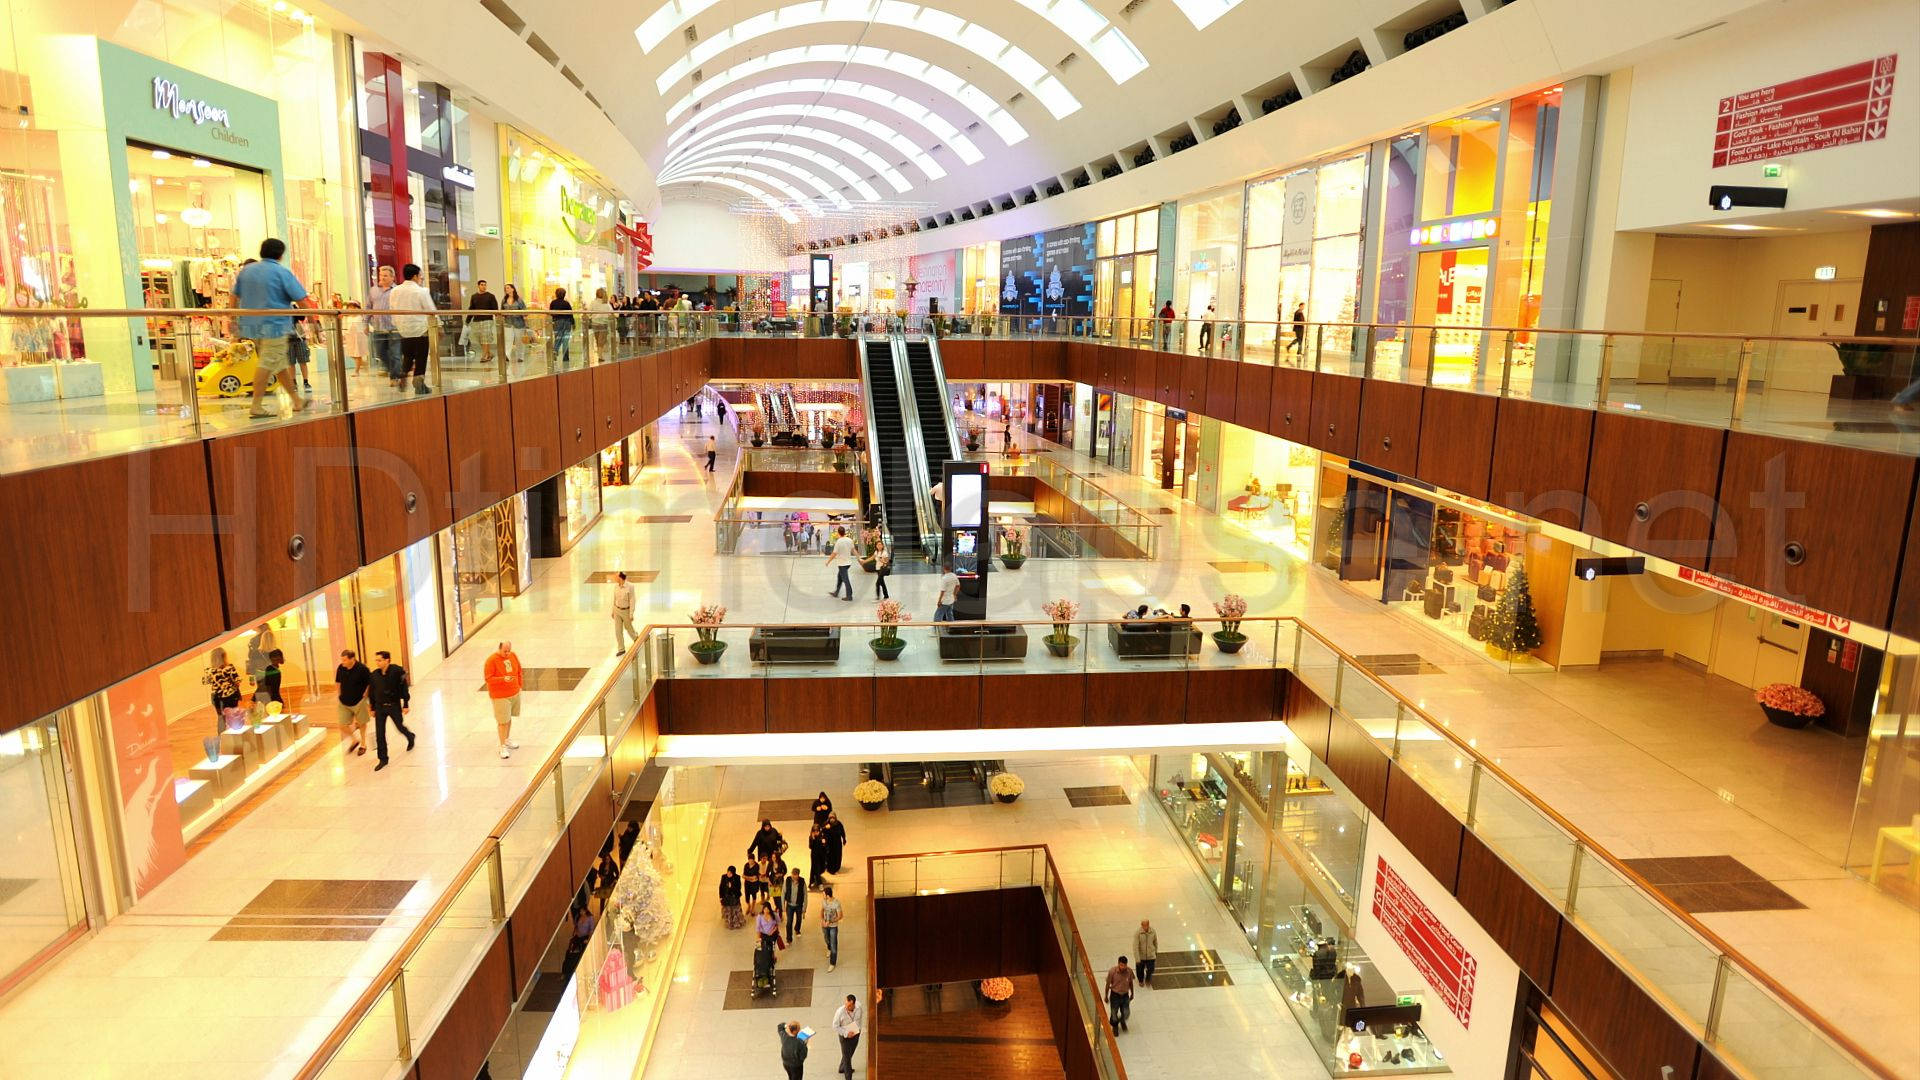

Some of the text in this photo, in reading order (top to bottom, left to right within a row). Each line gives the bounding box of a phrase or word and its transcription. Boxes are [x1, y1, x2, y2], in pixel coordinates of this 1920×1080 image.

[1760, 85, 1775, 96] here
[1722, 100, 1730, 113] 2
[1735, 103, 1782, 120] Fashion Avenue
[1733, 129, 1747, 138] Gold
[1748, 126, 1763, 134] Souk
[1768, 119, 1793, 130] Fashion
[1793, 114, 1819, 125] Avenue
[211, 126, 249, 147] Children
[1730, 147, 1745, 156] Food
[1746, 144, 1762, 153] Court
[1766, 140, 1781, 149] Lake
[1781, 135, 1810, 146] Fountain
[1814, 131, 1831, 140] Souk
[1832, 129, 1840, 137] Al
[1841, 125, 1861, 135] Bahar
[1376, 888, 1382, 903] G
